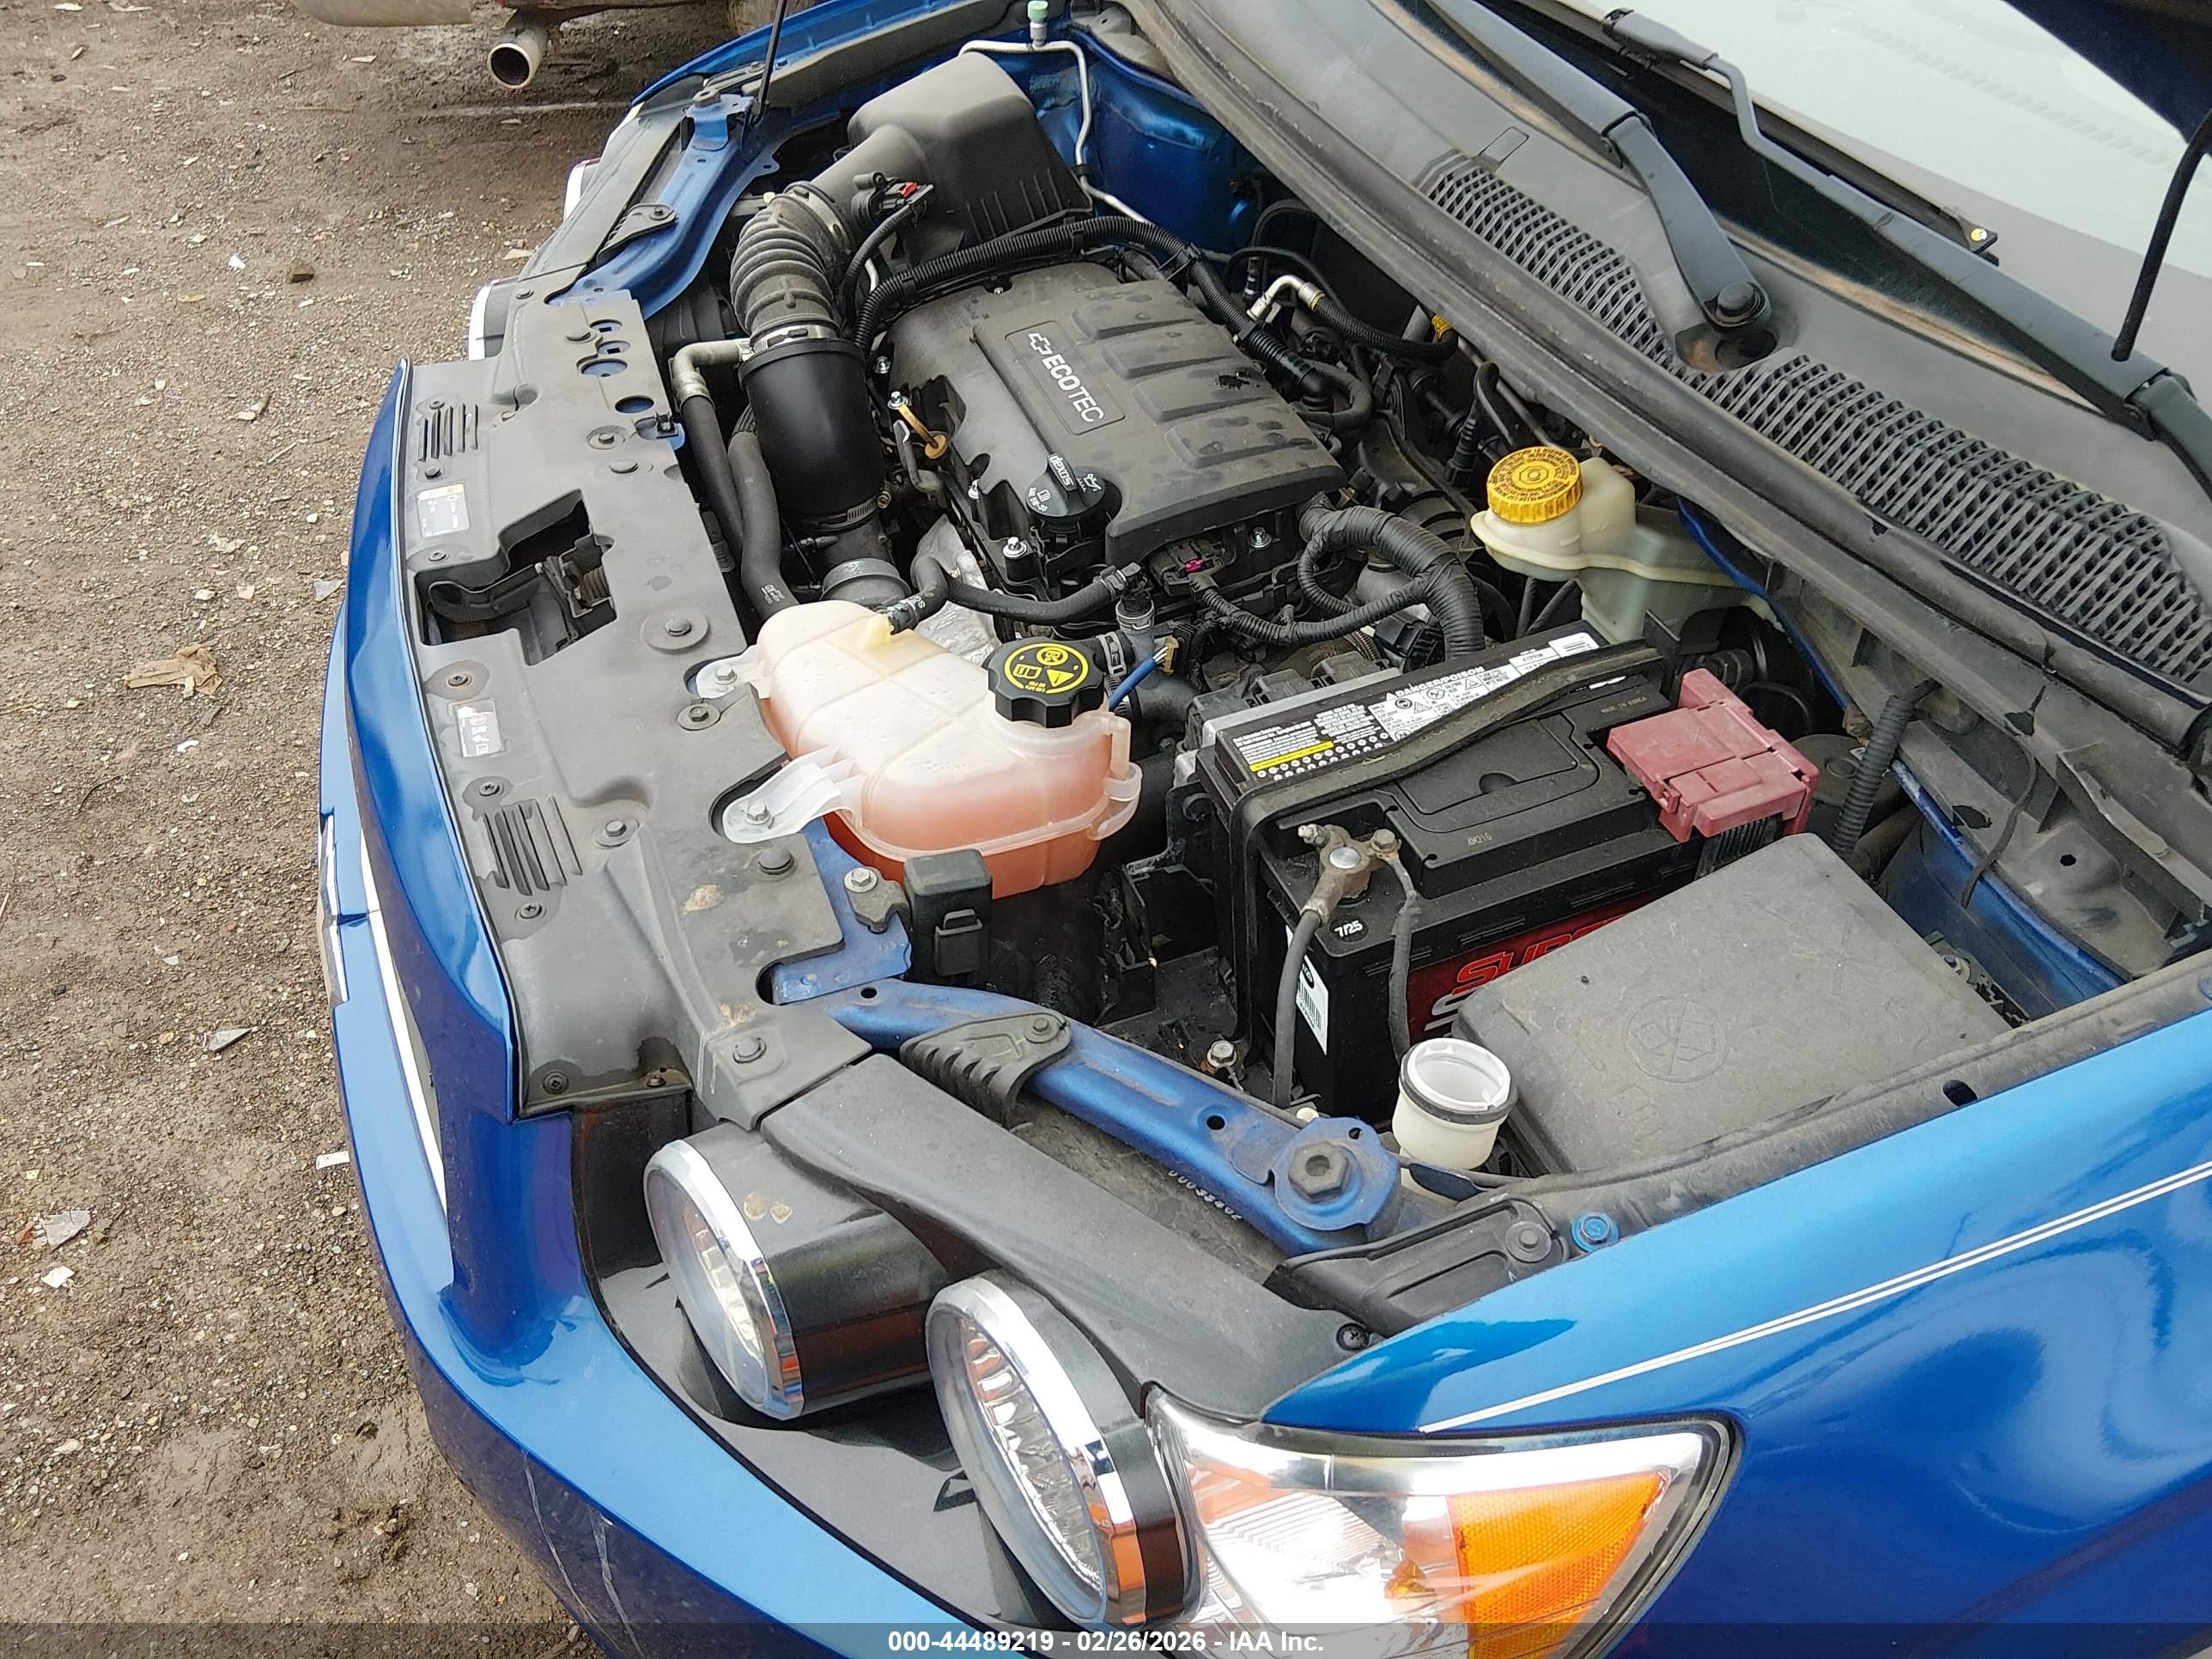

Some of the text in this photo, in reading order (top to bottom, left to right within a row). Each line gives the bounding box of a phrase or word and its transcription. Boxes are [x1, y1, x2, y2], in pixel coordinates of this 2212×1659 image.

[1042, 353, 1104, 422] ECOTEC
[1048, 455, 1074, 488] dexos
[1395, 666, 1485, 696] DANGER/POISON
[1333, 919, 1364, 938] 7/25
